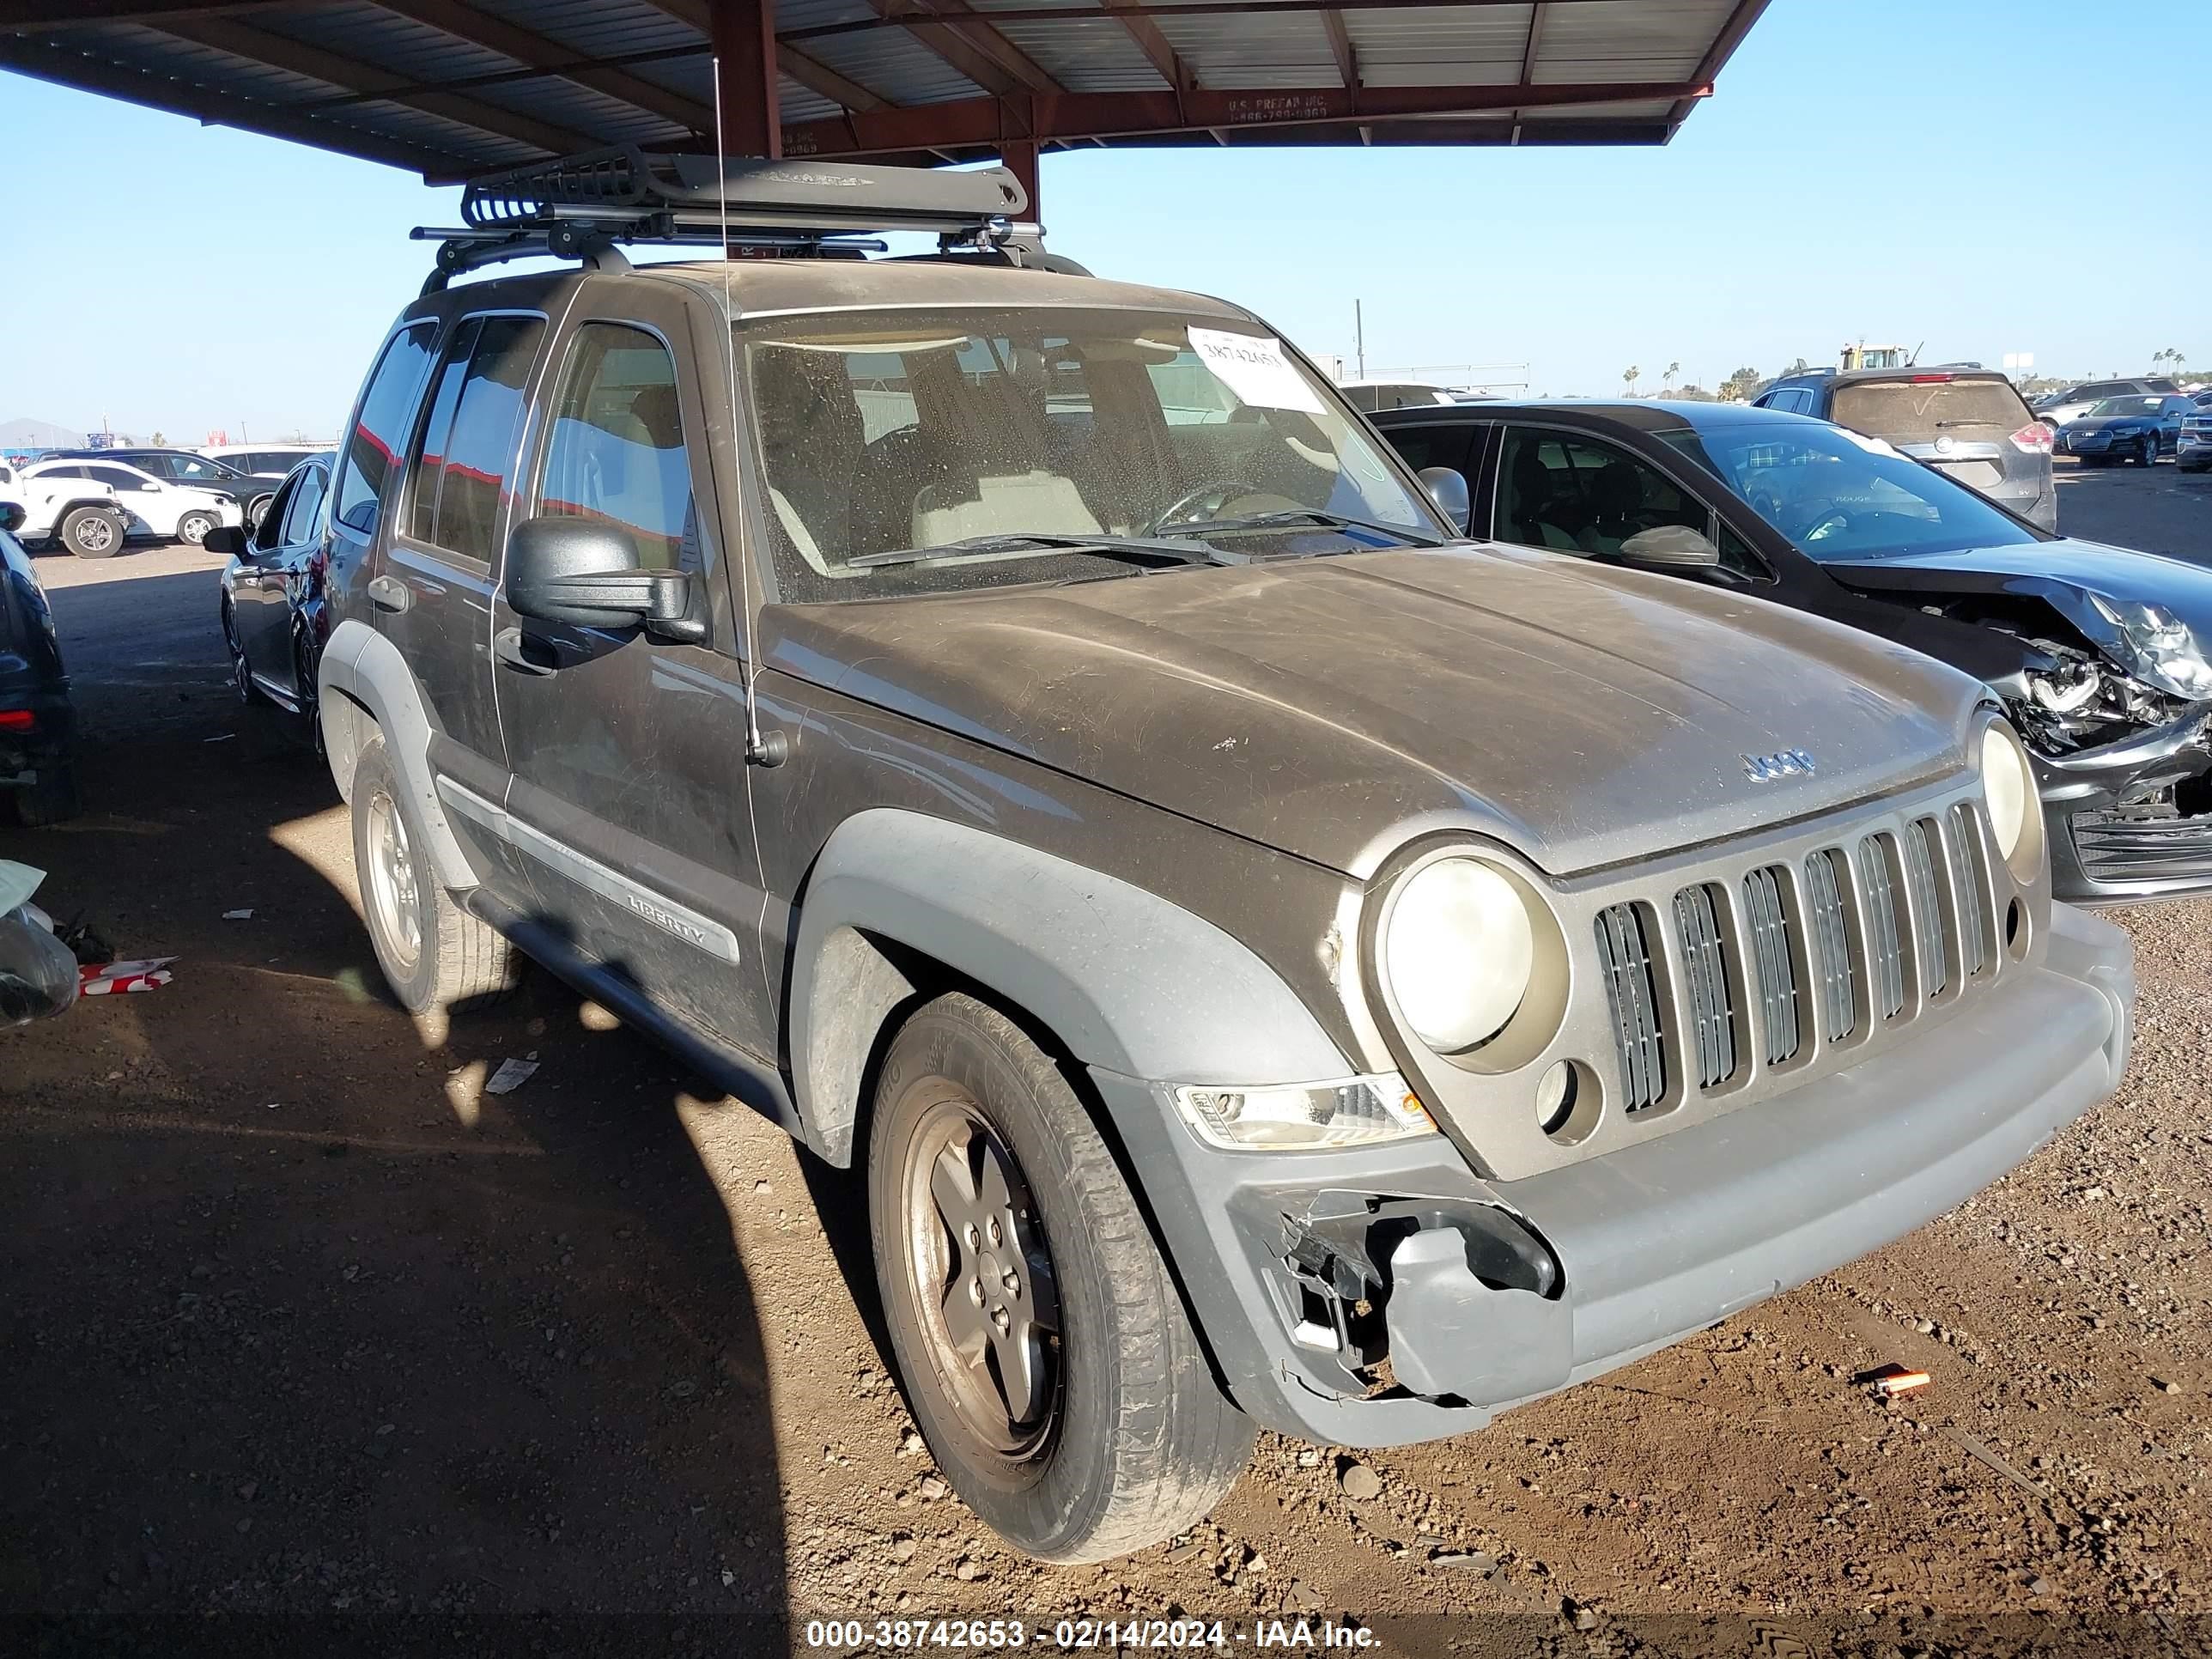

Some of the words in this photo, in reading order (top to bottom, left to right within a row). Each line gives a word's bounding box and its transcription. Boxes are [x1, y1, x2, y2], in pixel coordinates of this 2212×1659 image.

[1739, 748, 1815, 783] Jeep
[628, 895, 707, 943] LIBERTY
[868, 1060, 902, 1170] KUMHO
